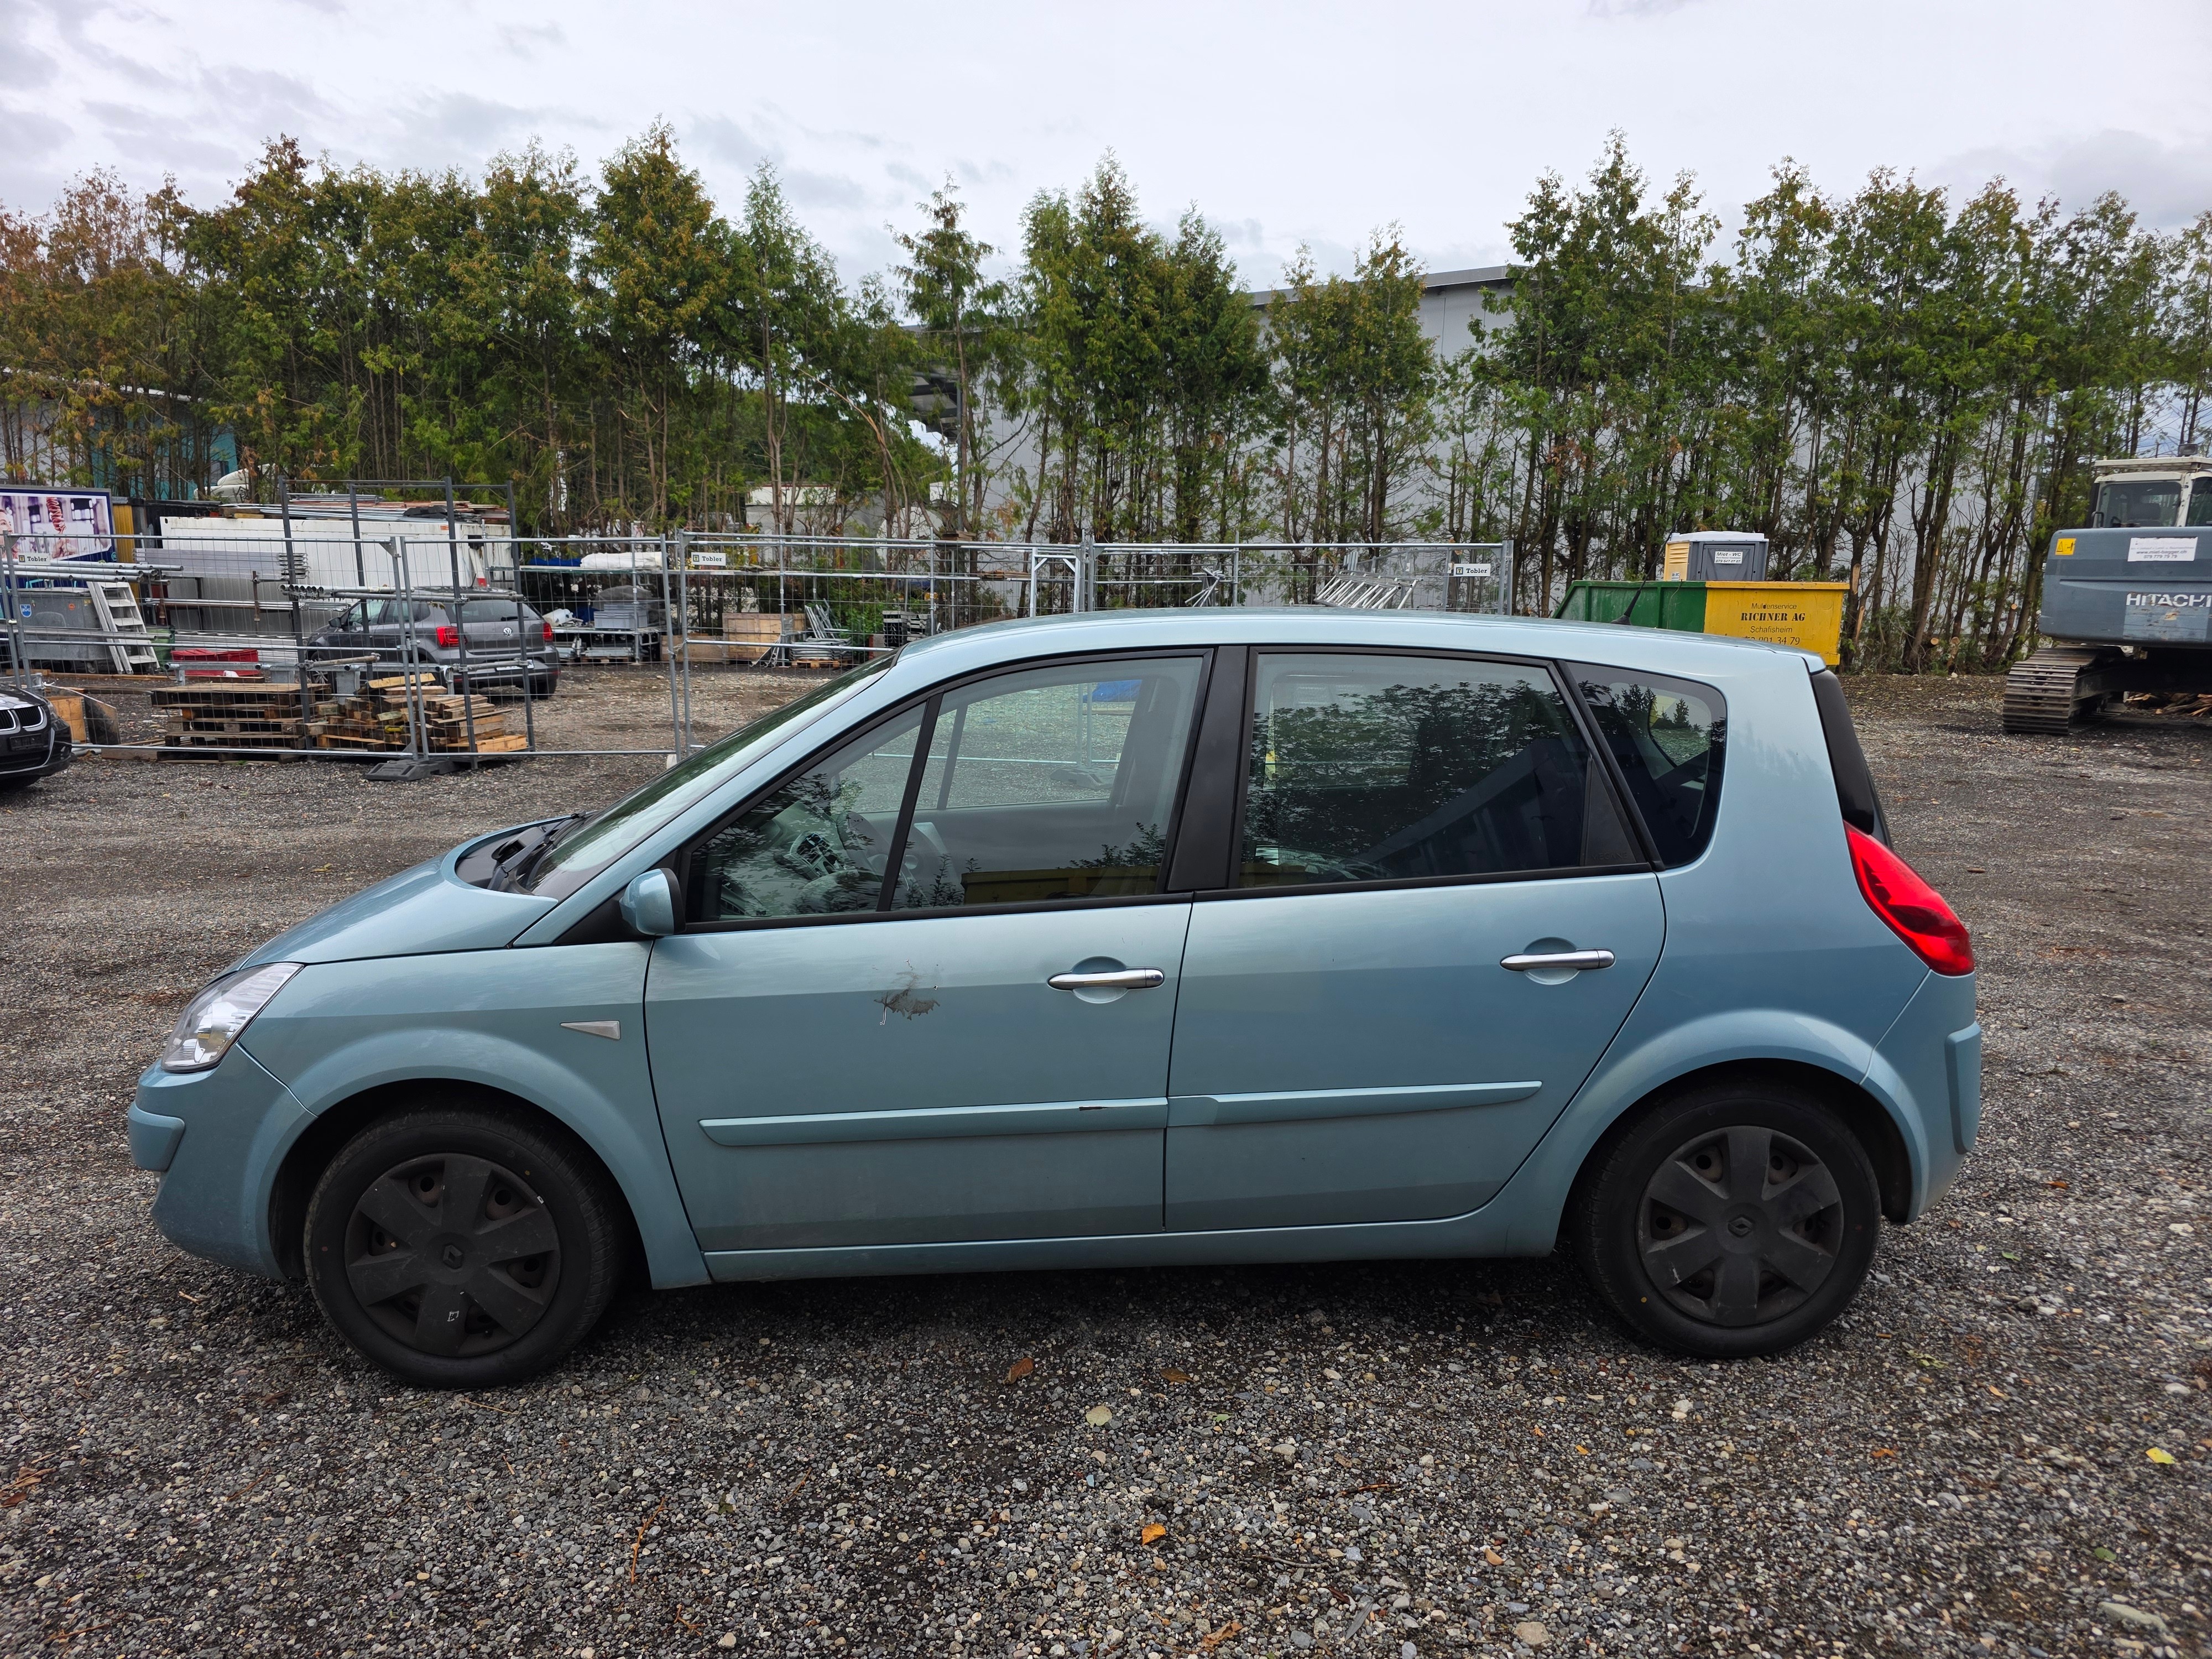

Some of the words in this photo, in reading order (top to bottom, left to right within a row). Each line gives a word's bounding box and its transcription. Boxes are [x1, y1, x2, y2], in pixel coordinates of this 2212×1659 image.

[2126, 593, 2212, 607] HITACHI
[1741, 612, 1788, 621] RICHNER
[1792, 613, 1806, 621] AG
[1777, 637, 1787, 645] 34
[1790, 637, 1801, 645] 79
